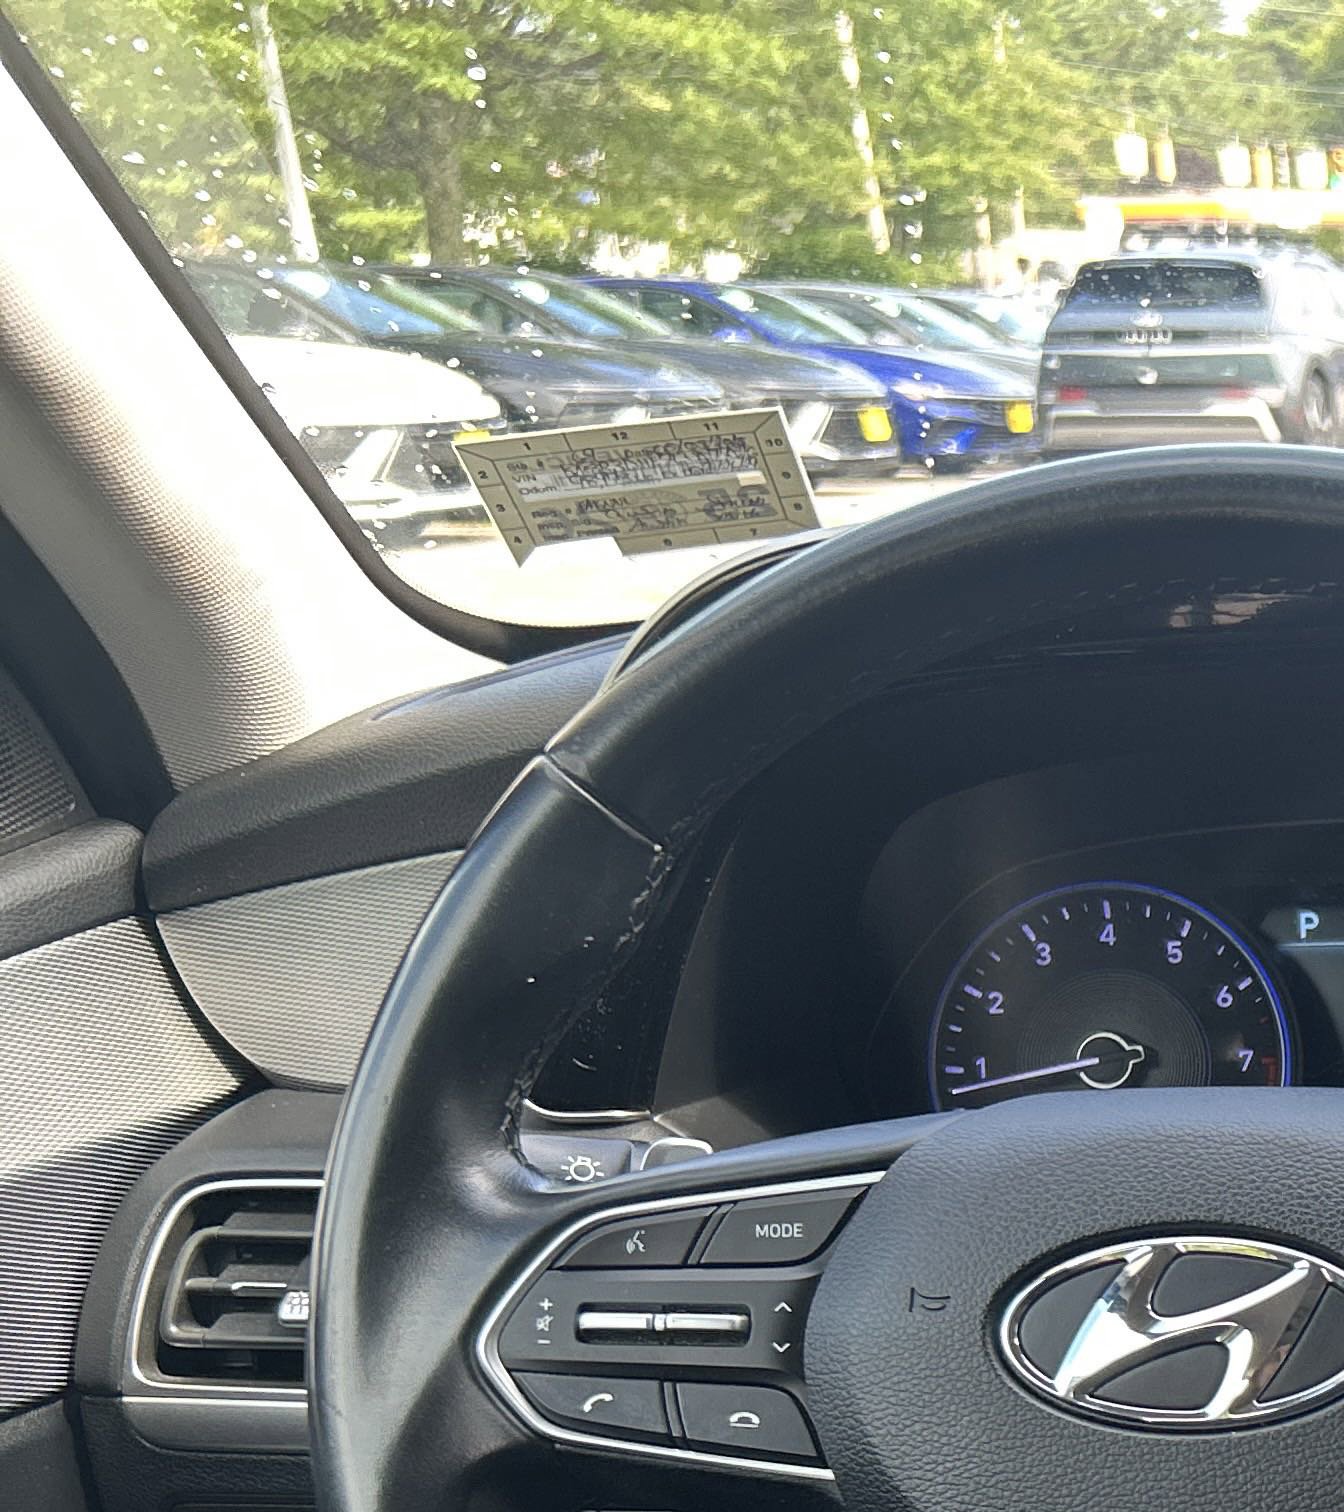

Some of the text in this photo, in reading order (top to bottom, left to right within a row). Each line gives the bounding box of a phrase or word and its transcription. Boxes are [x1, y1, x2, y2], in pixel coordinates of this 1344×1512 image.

[1099, 923, 1117, 946] 4
[1300, 911, 1320, 938] P
[1035, 942, 1052, 966] 3
[1166, 941, 1183, 964] 5
[988, 992, 1005, 1014] 2
[1215, 985, 1233, 1008] 6
[975, 1057, 986, 1079] 1
[1237, 1049, 1254, 1072] 7
[755, 1223, 804, 1239] MODE
